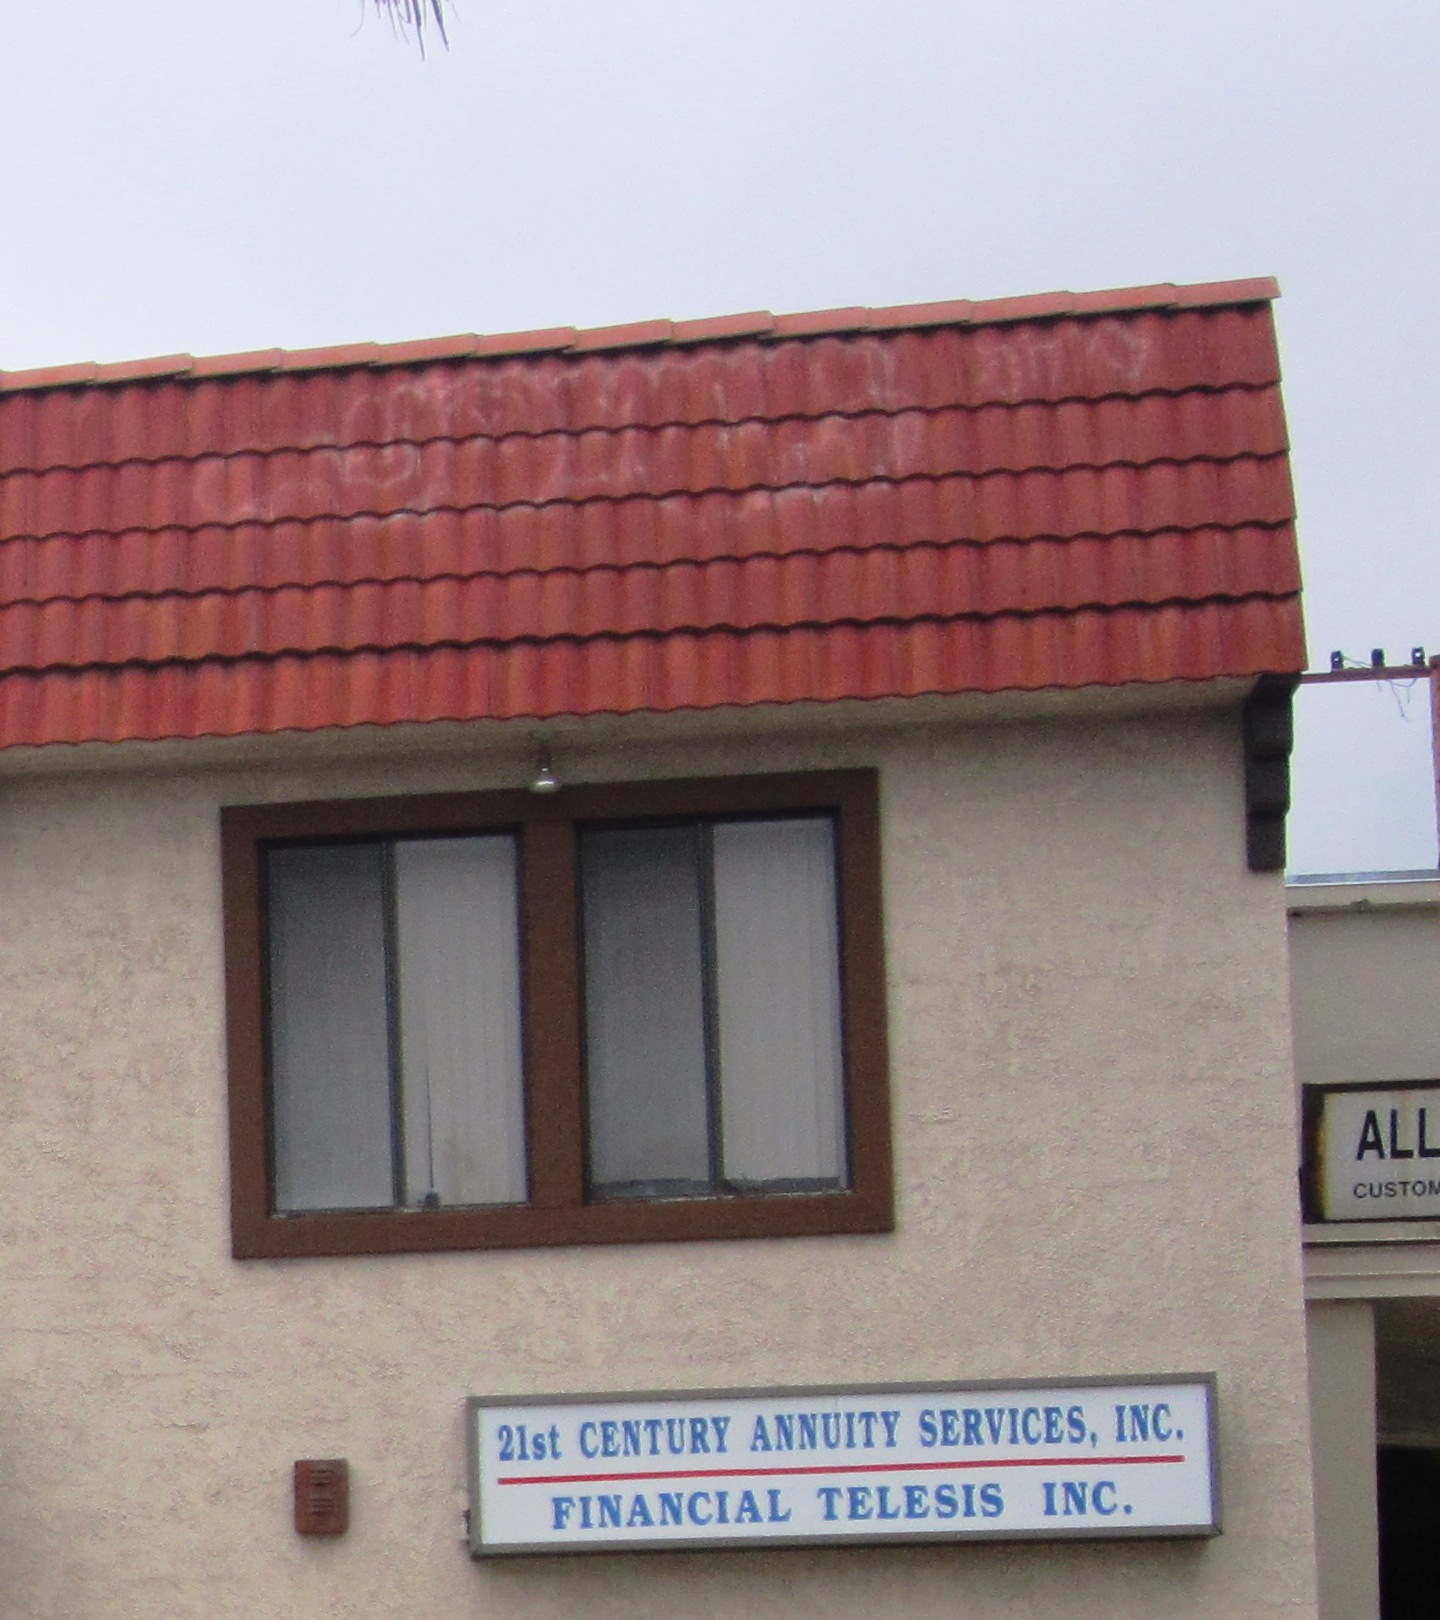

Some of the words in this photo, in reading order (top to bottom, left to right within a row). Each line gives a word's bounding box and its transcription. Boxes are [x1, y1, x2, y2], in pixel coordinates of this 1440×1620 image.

[1356, 1108, 1440, 1161] ALL
[1353, 1180, 1440, 1199] CUSTOM
[497, 1423, 561, 1463] 21st
[578, 1414, 733, 1459] CENTURY
[750, 1408, 902, 1454] ANNUITY
[919, 1404, 1099, 1449] SERVICES,
[1115, 1402, 1185, 1442] INC.
[551, 1487, 792, 1530] FINANCIAL
[818, 1482, 1006, 1522] TELESIS
[1043, 1479, 1134, 1517] INC.
